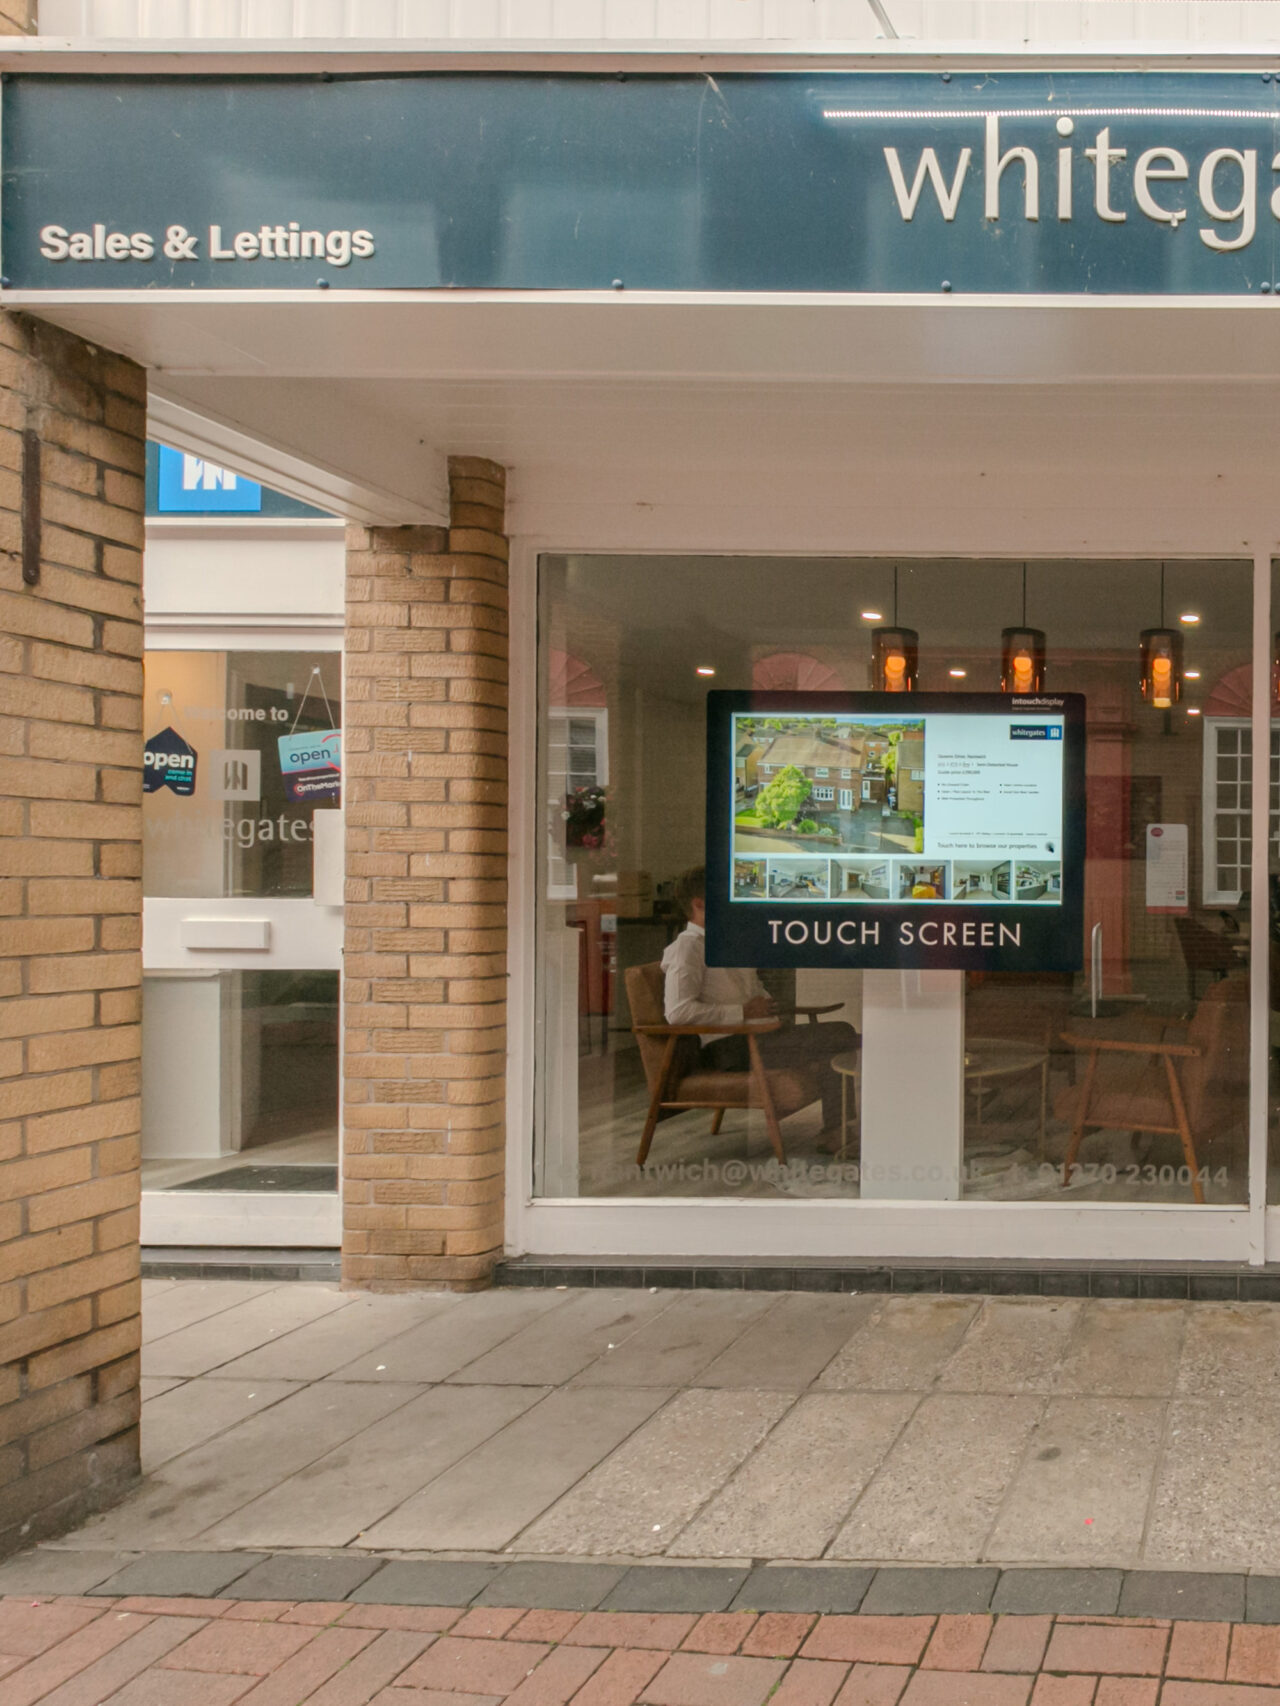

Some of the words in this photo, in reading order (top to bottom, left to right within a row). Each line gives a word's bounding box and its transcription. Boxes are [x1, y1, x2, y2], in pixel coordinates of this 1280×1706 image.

[40, 222, 154, 262] Sales
[164, 225, 198, 261] &
[209, 221, 375, 267] Lettings
[1011, 696, 1065, 707] intouchdisplay
[270, 706, 289, 721] to
[1011, 728, 1046, 738] whitegates
[143, 751, 195, 771] open
[289, 749, 331, 765] open
[768, 920, 880, 946] TOUCH
[899, 921, 1021, 947] SCREEN
[1037, 1161, 1117, 1185] 01270
[1124, 1163, 1230, 1188] 230044
